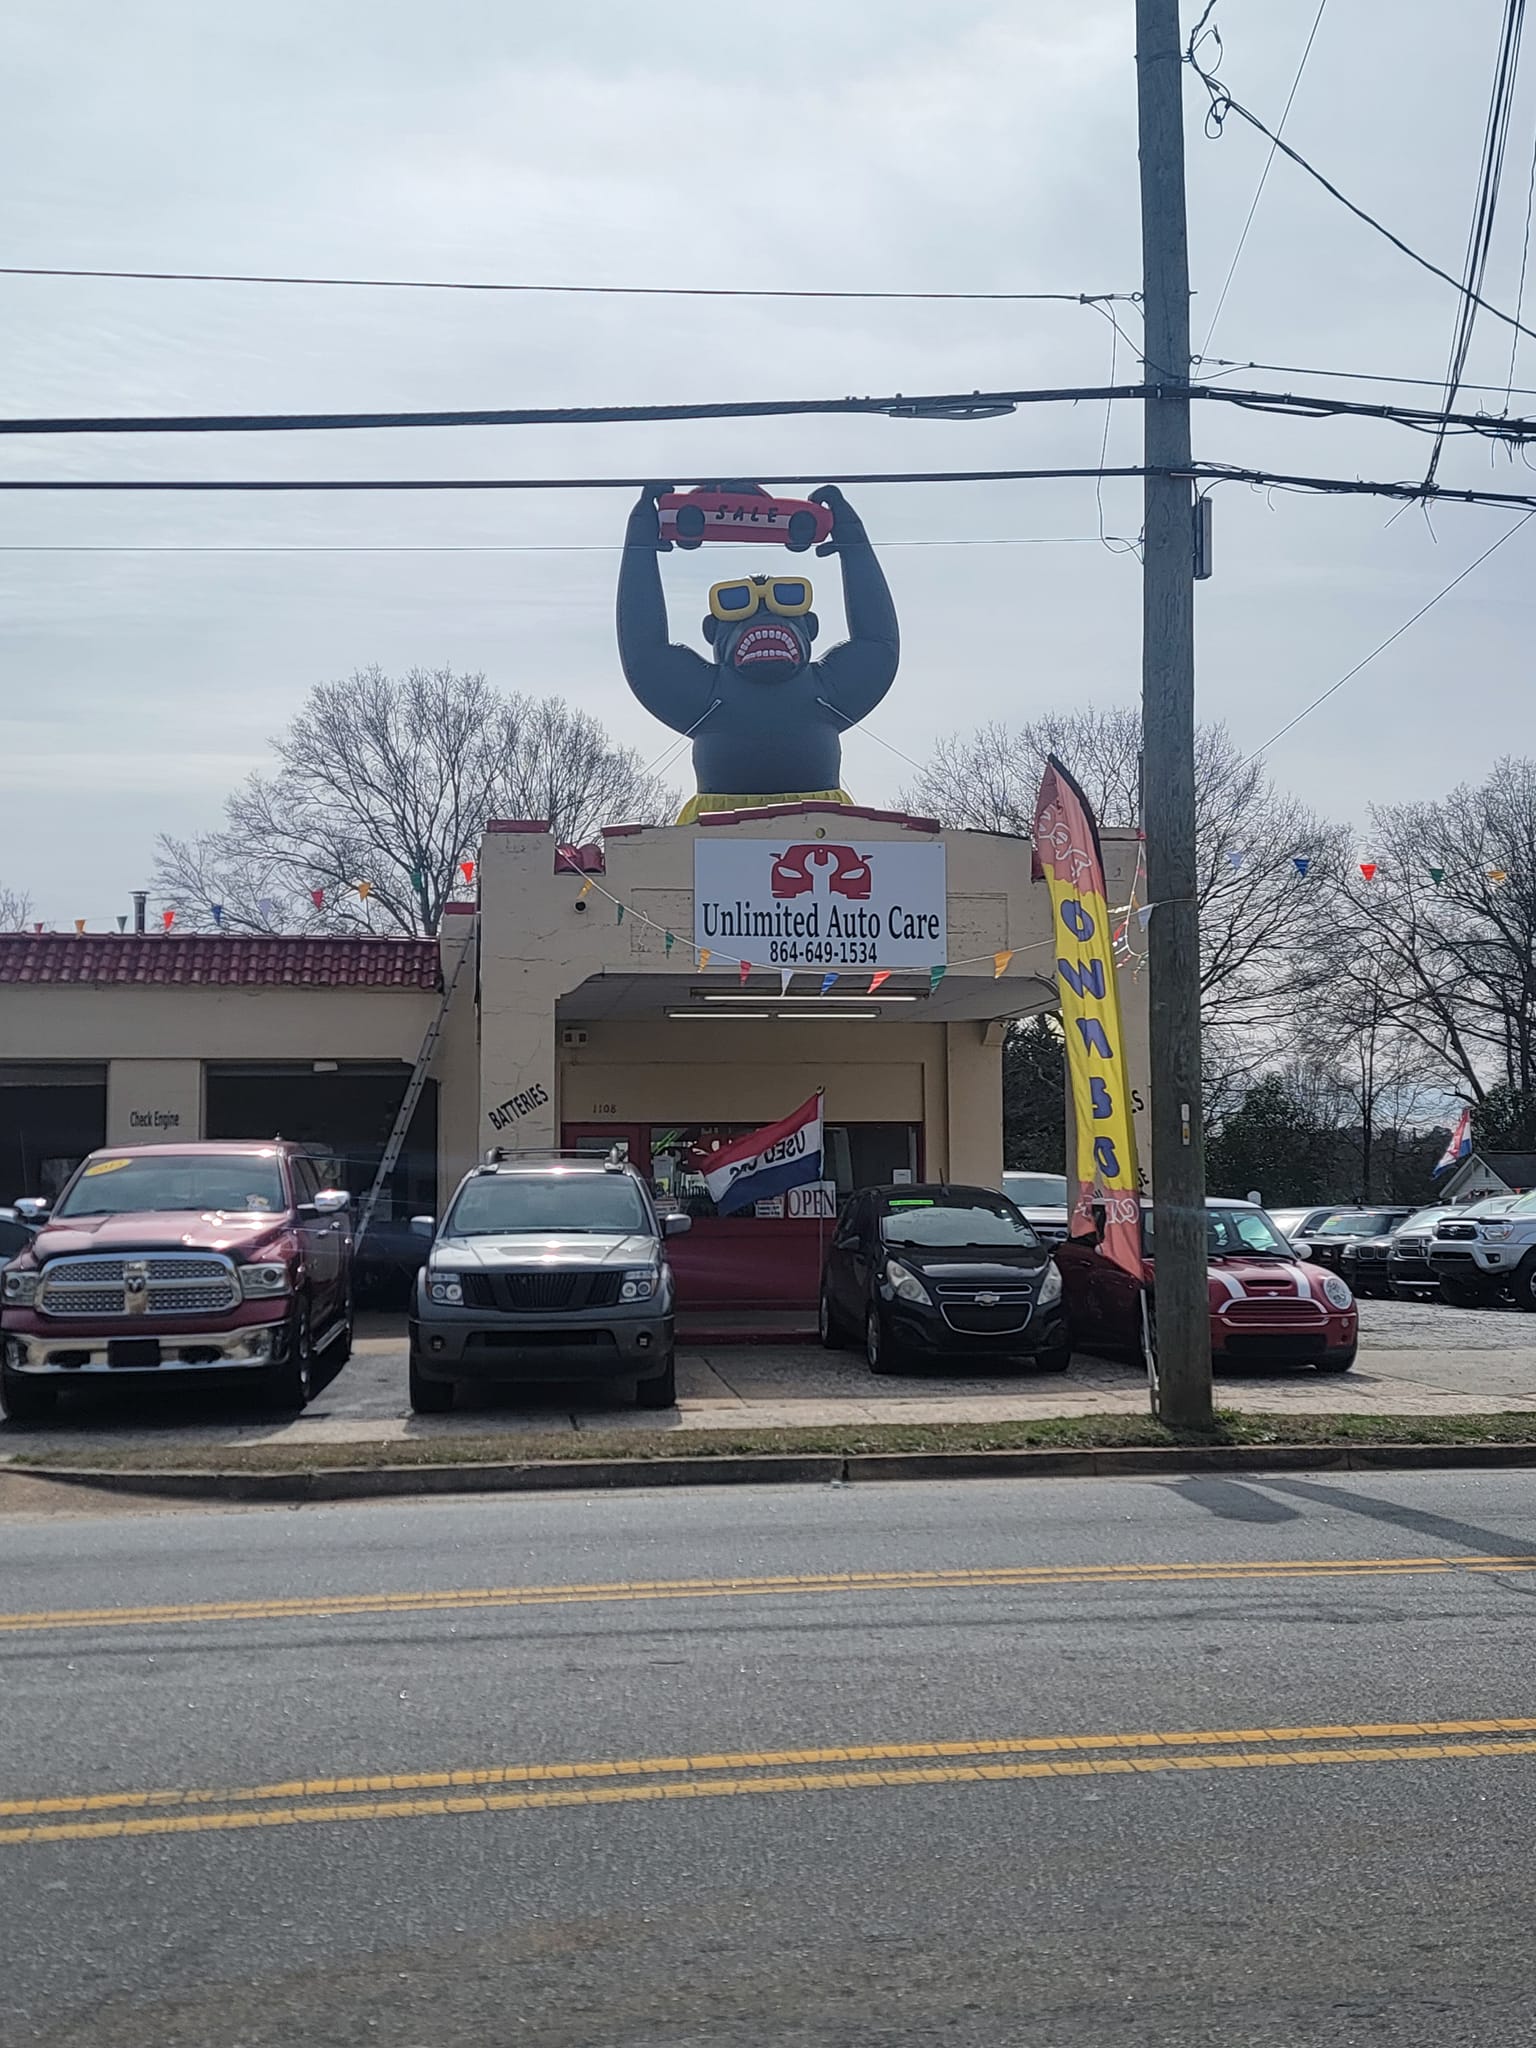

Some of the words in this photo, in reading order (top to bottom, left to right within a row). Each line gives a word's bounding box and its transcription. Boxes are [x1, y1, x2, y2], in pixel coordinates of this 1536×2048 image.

[715, 504, 779, 523] SALE
[702, 901, 820, 938] Unlimited
[826, 904, 881, 939] Auto
[888, 905, 940, 940] Care
[770, 940, 878, 964] 864-649-1534
[488, 1083, 549, 1130] BATTERIES
[130, 1111, 153, 1127] Check
[154, 1110, 180, 1130] Engine
[788, 1189, 835, 1217] OPEN
